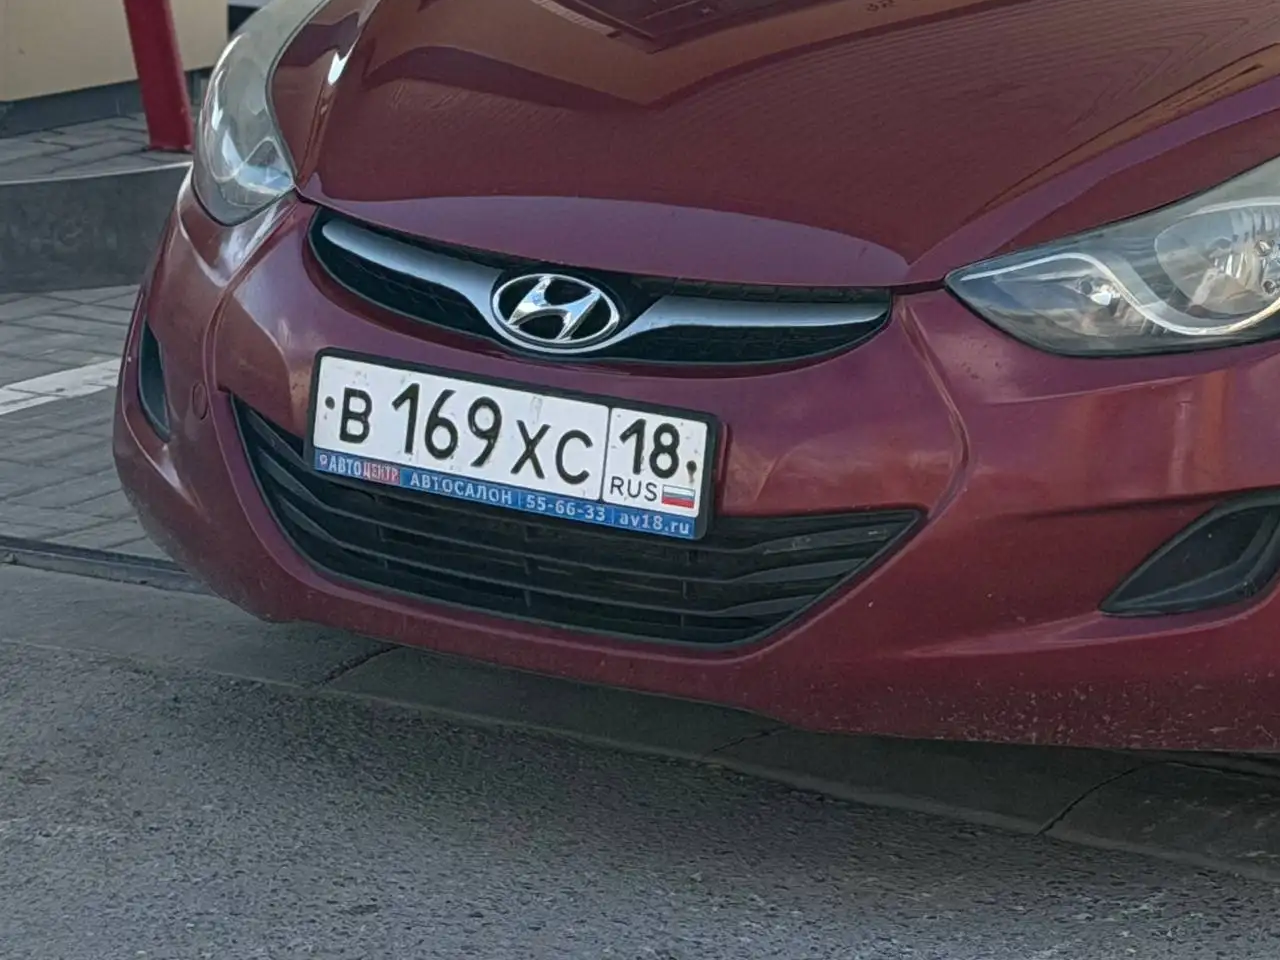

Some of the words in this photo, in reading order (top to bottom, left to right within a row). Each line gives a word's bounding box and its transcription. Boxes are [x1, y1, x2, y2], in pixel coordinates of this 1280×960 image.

[618, 417, 681, 480] 18
[410, 472, 513, 505] АВТОСАЛОН
[525, 493, 606, 522] 55-66-33
[619, 511, 690, 535] av18.ru
[609, 475, 658, 503] RUS
